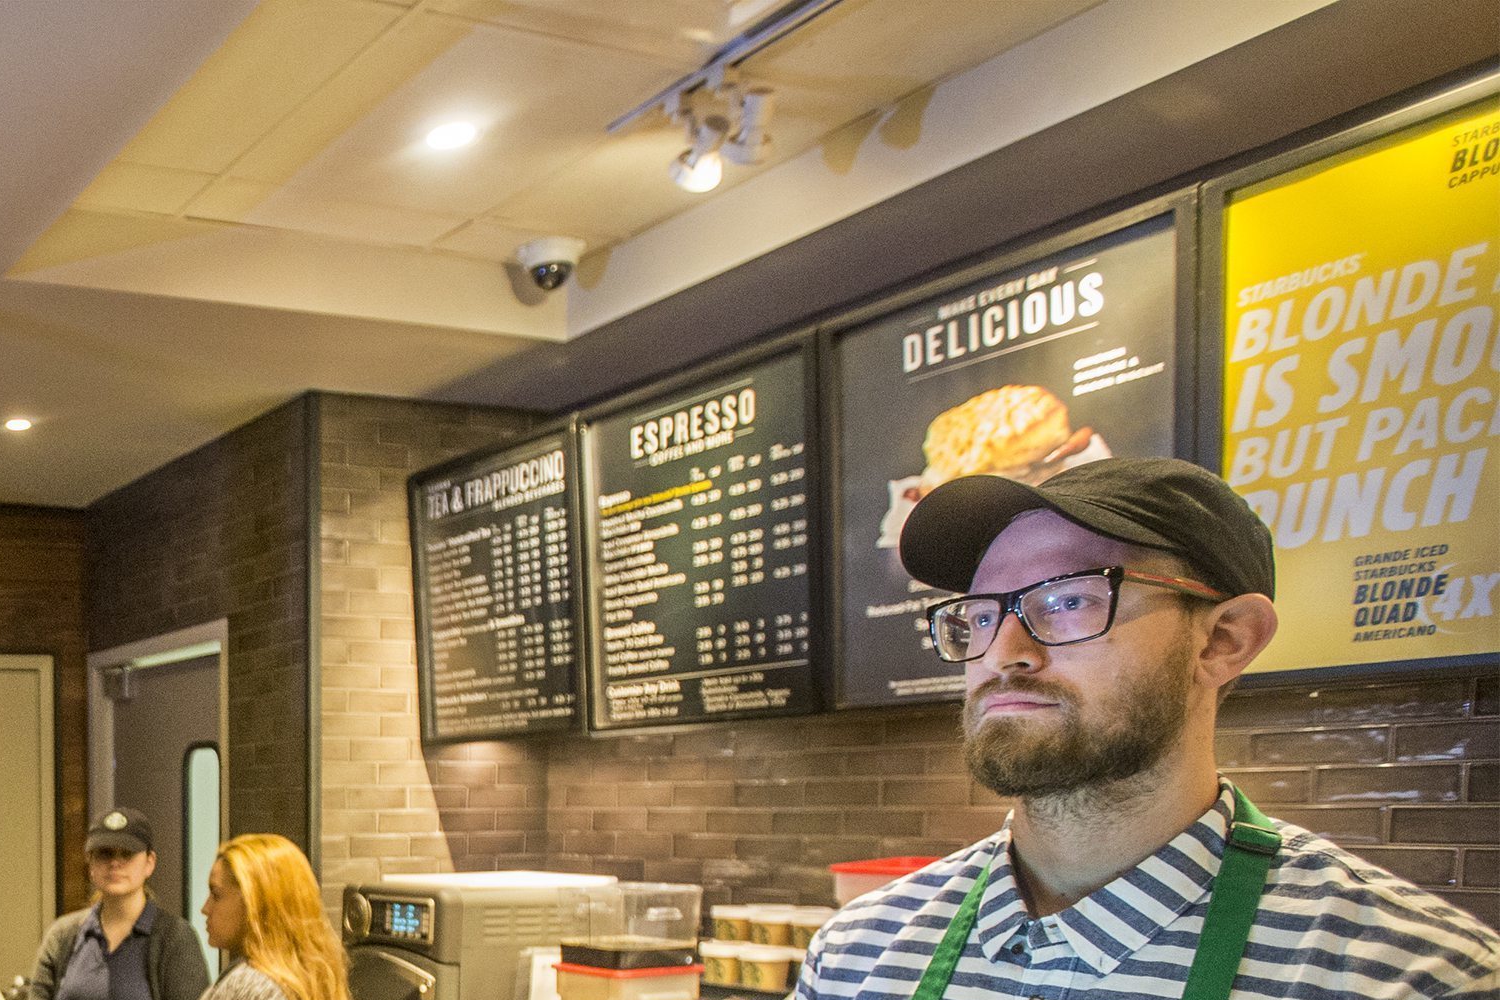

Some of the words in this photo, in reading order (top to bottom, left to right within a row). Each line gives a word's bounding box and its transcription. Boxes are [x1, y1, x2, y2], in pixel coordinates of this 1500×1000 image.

[1229, 242, 1489, 363] BLONDE
[1236, 253, 1363, 307] STARBUCKS
[903, 272, 1104, 373] DELICIOUS
[1231, 354, 1300, 433] IS
[1316, 305, 1500, 414] SMO
[630, 387, 756, 459] ESPRESSO
[648, 443, 684, 467] COFFEE
[684, 438, 705, 456] AND
[705, 429, 734, 449] MORE
[1229, 415, 1350, 488] BUT
[426, 491, 449, 519] TEA
[450, 485, 464, 513] &
[464, 450, 565, 509] FRAPPUCCINO
[1354, 549, 1411, 567] GRANDE
[1414, 544, 1449, 559] ICED
[1354, 560, 1437, 581] STARBUCKS
[1353, 573, 1449, 604] BLONDE
[1354, 601, 1420, 627] QUAD
[1353, 624, 1437, 642] AMERICANO
